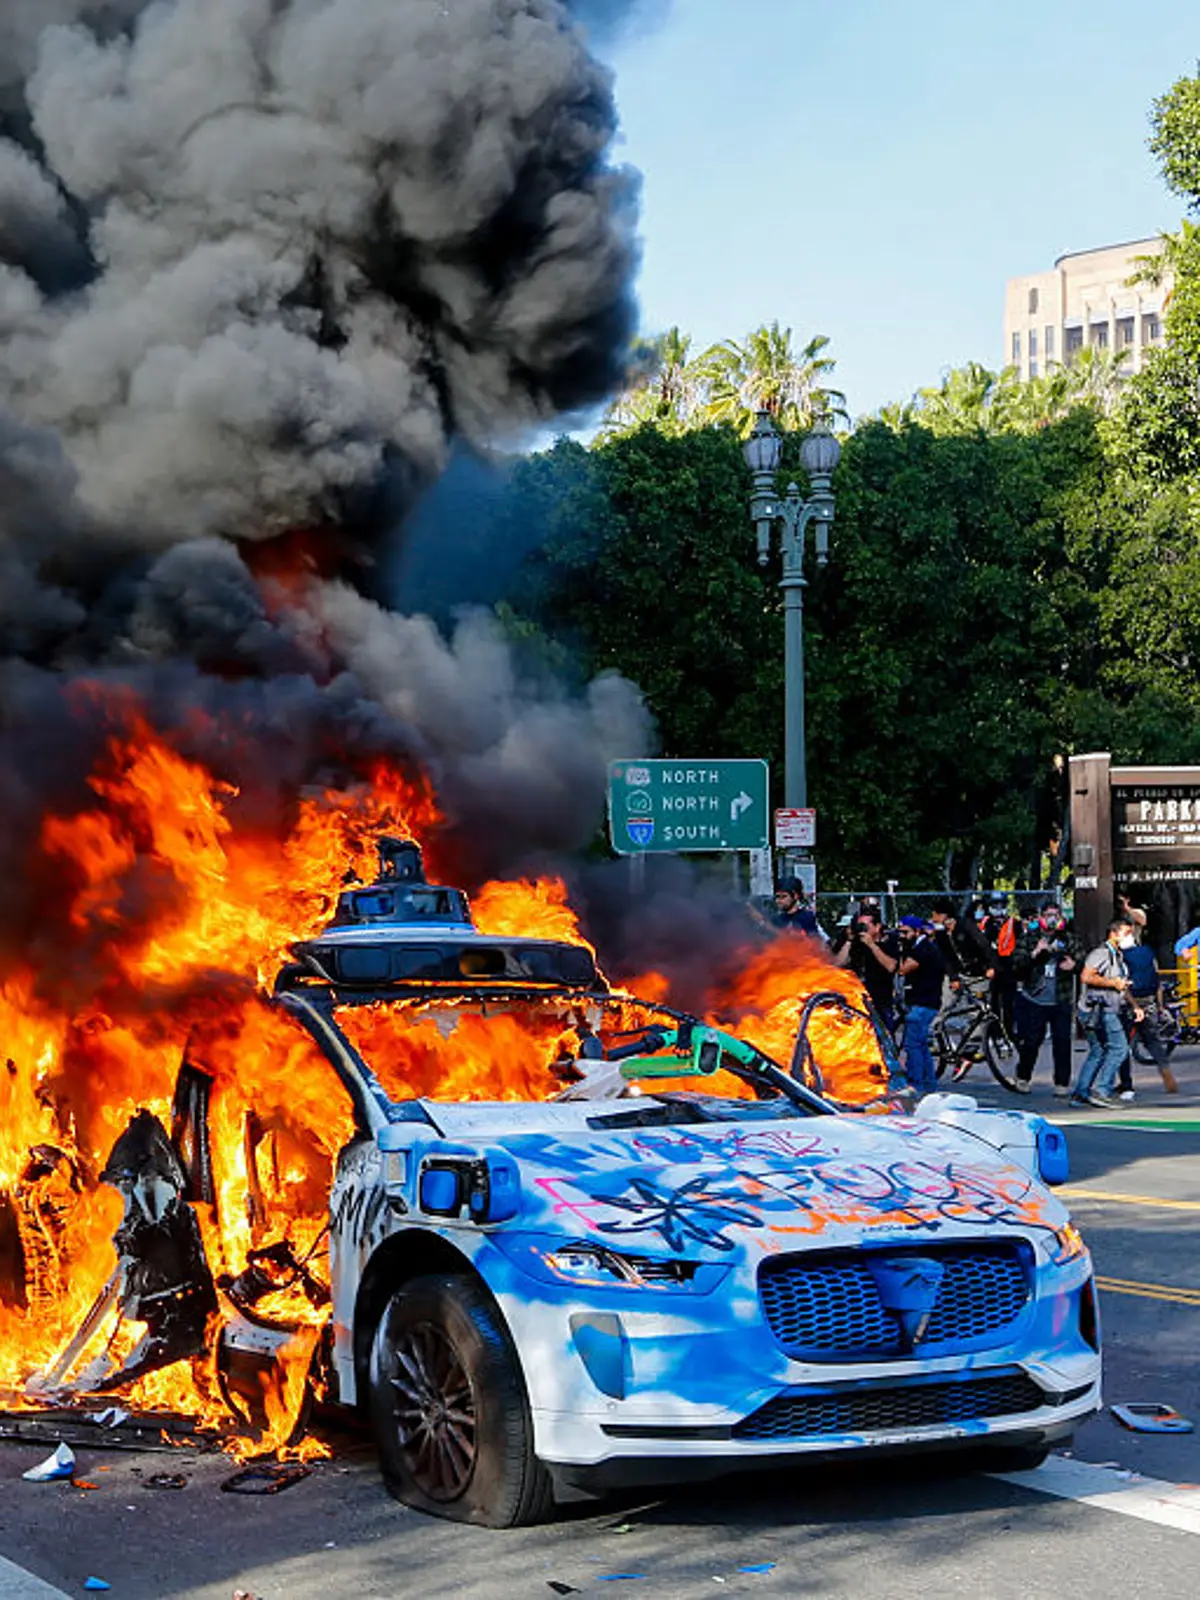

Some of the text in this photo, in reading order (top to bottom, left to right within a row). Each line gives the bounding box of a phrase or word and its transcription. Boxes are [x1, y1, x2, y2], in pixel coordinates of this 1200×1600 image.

[662, 770, 719, 783] NORTH
[662, 797, 719, 810] NORTH
[662, 826, 720, 841] SOUTH
